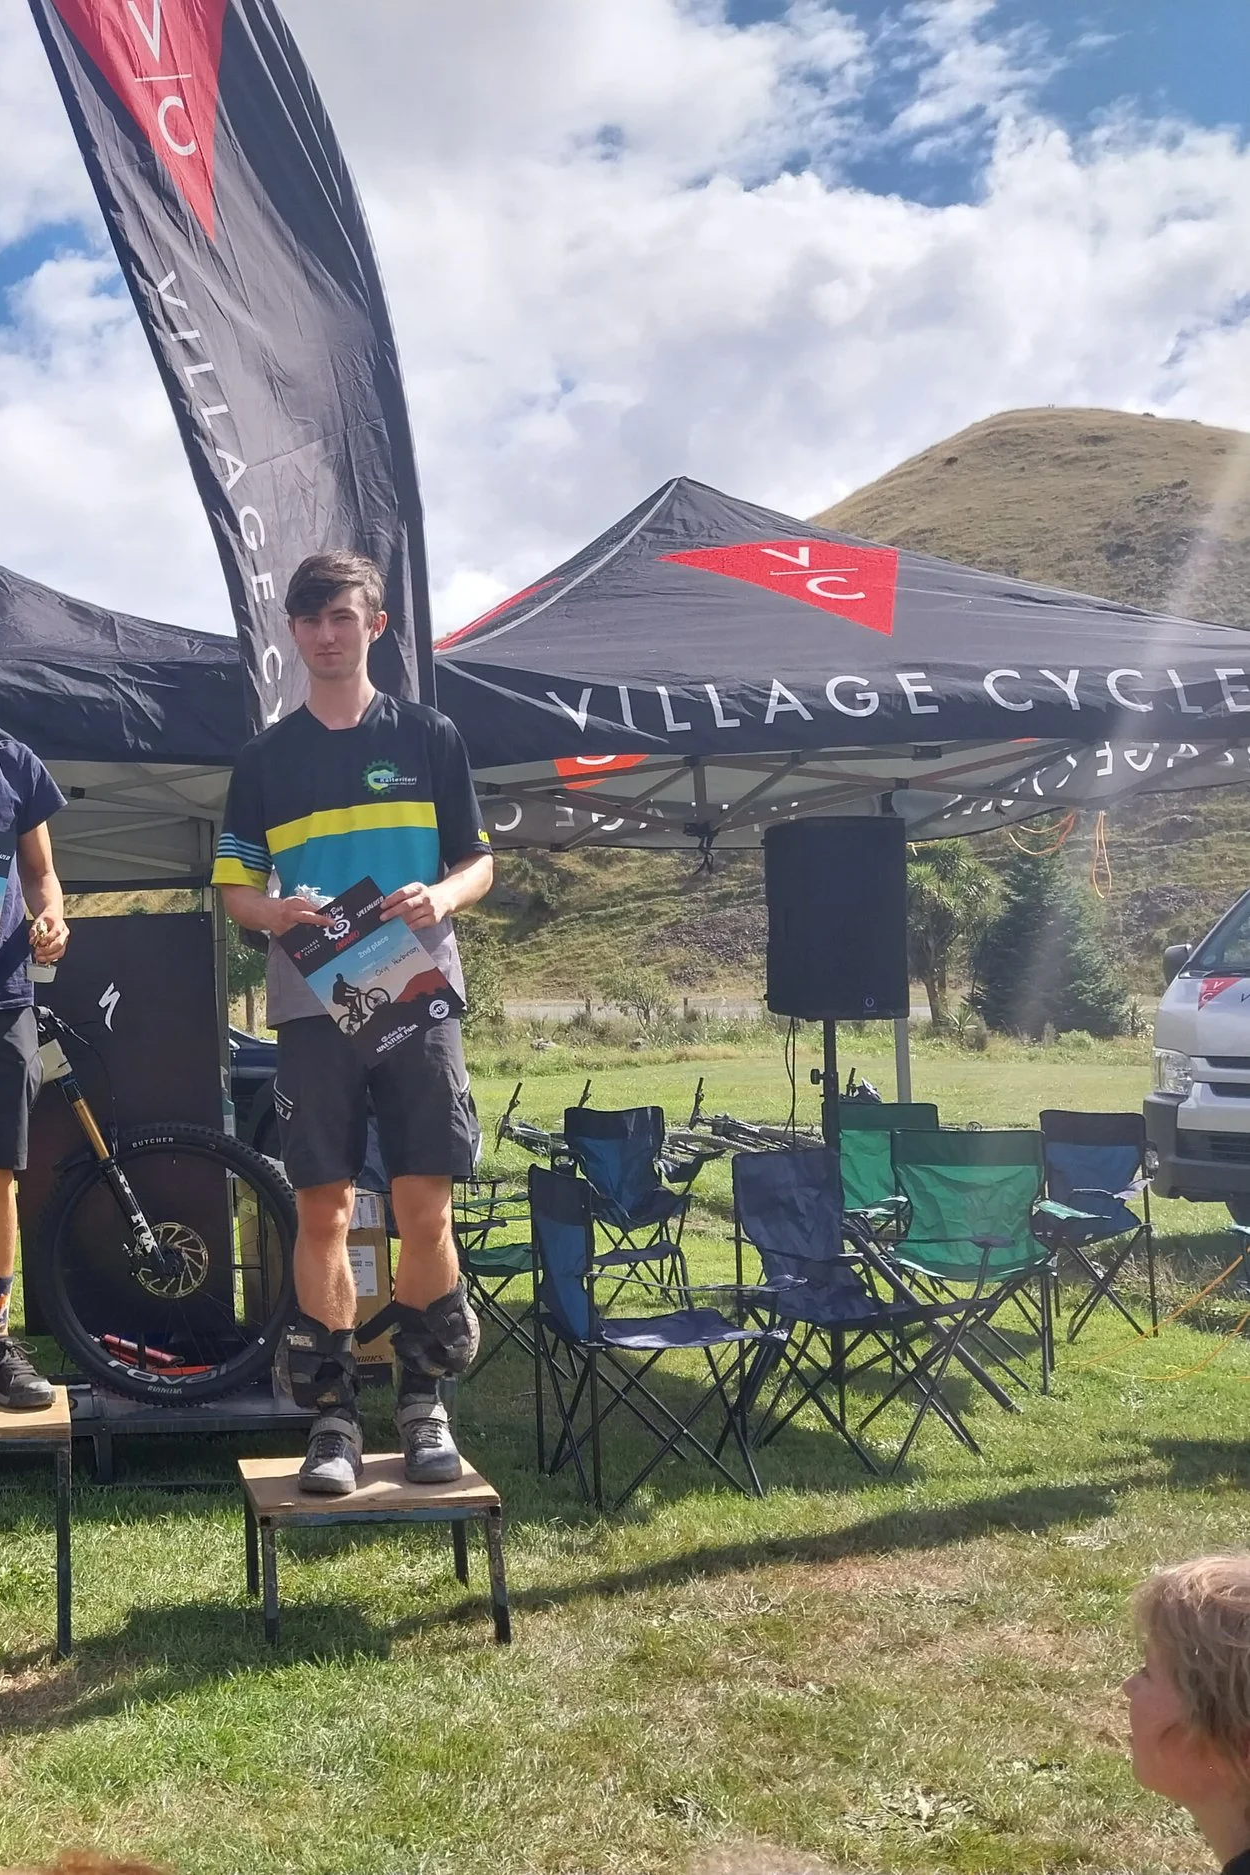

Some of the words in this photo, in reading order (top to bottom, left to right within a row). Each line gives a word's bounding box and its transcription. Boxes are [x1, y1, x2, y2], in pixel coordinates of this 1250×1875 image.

[128, 0, 161, 63] V
[157, 96, 196, 156] C
[157, 270, 275, 601] VILLAGE
[760, 547, 809, 568] V
[806, 576, 866, 600] C
[546, 672, 940, 733] VILLAGE
[983, 668, 1250, 714] CYCLE
[357, 947, 372, 959] 2nd
[371, 935, 390, 952] place
[132, 1137, 175, 1149] BUTCHER
